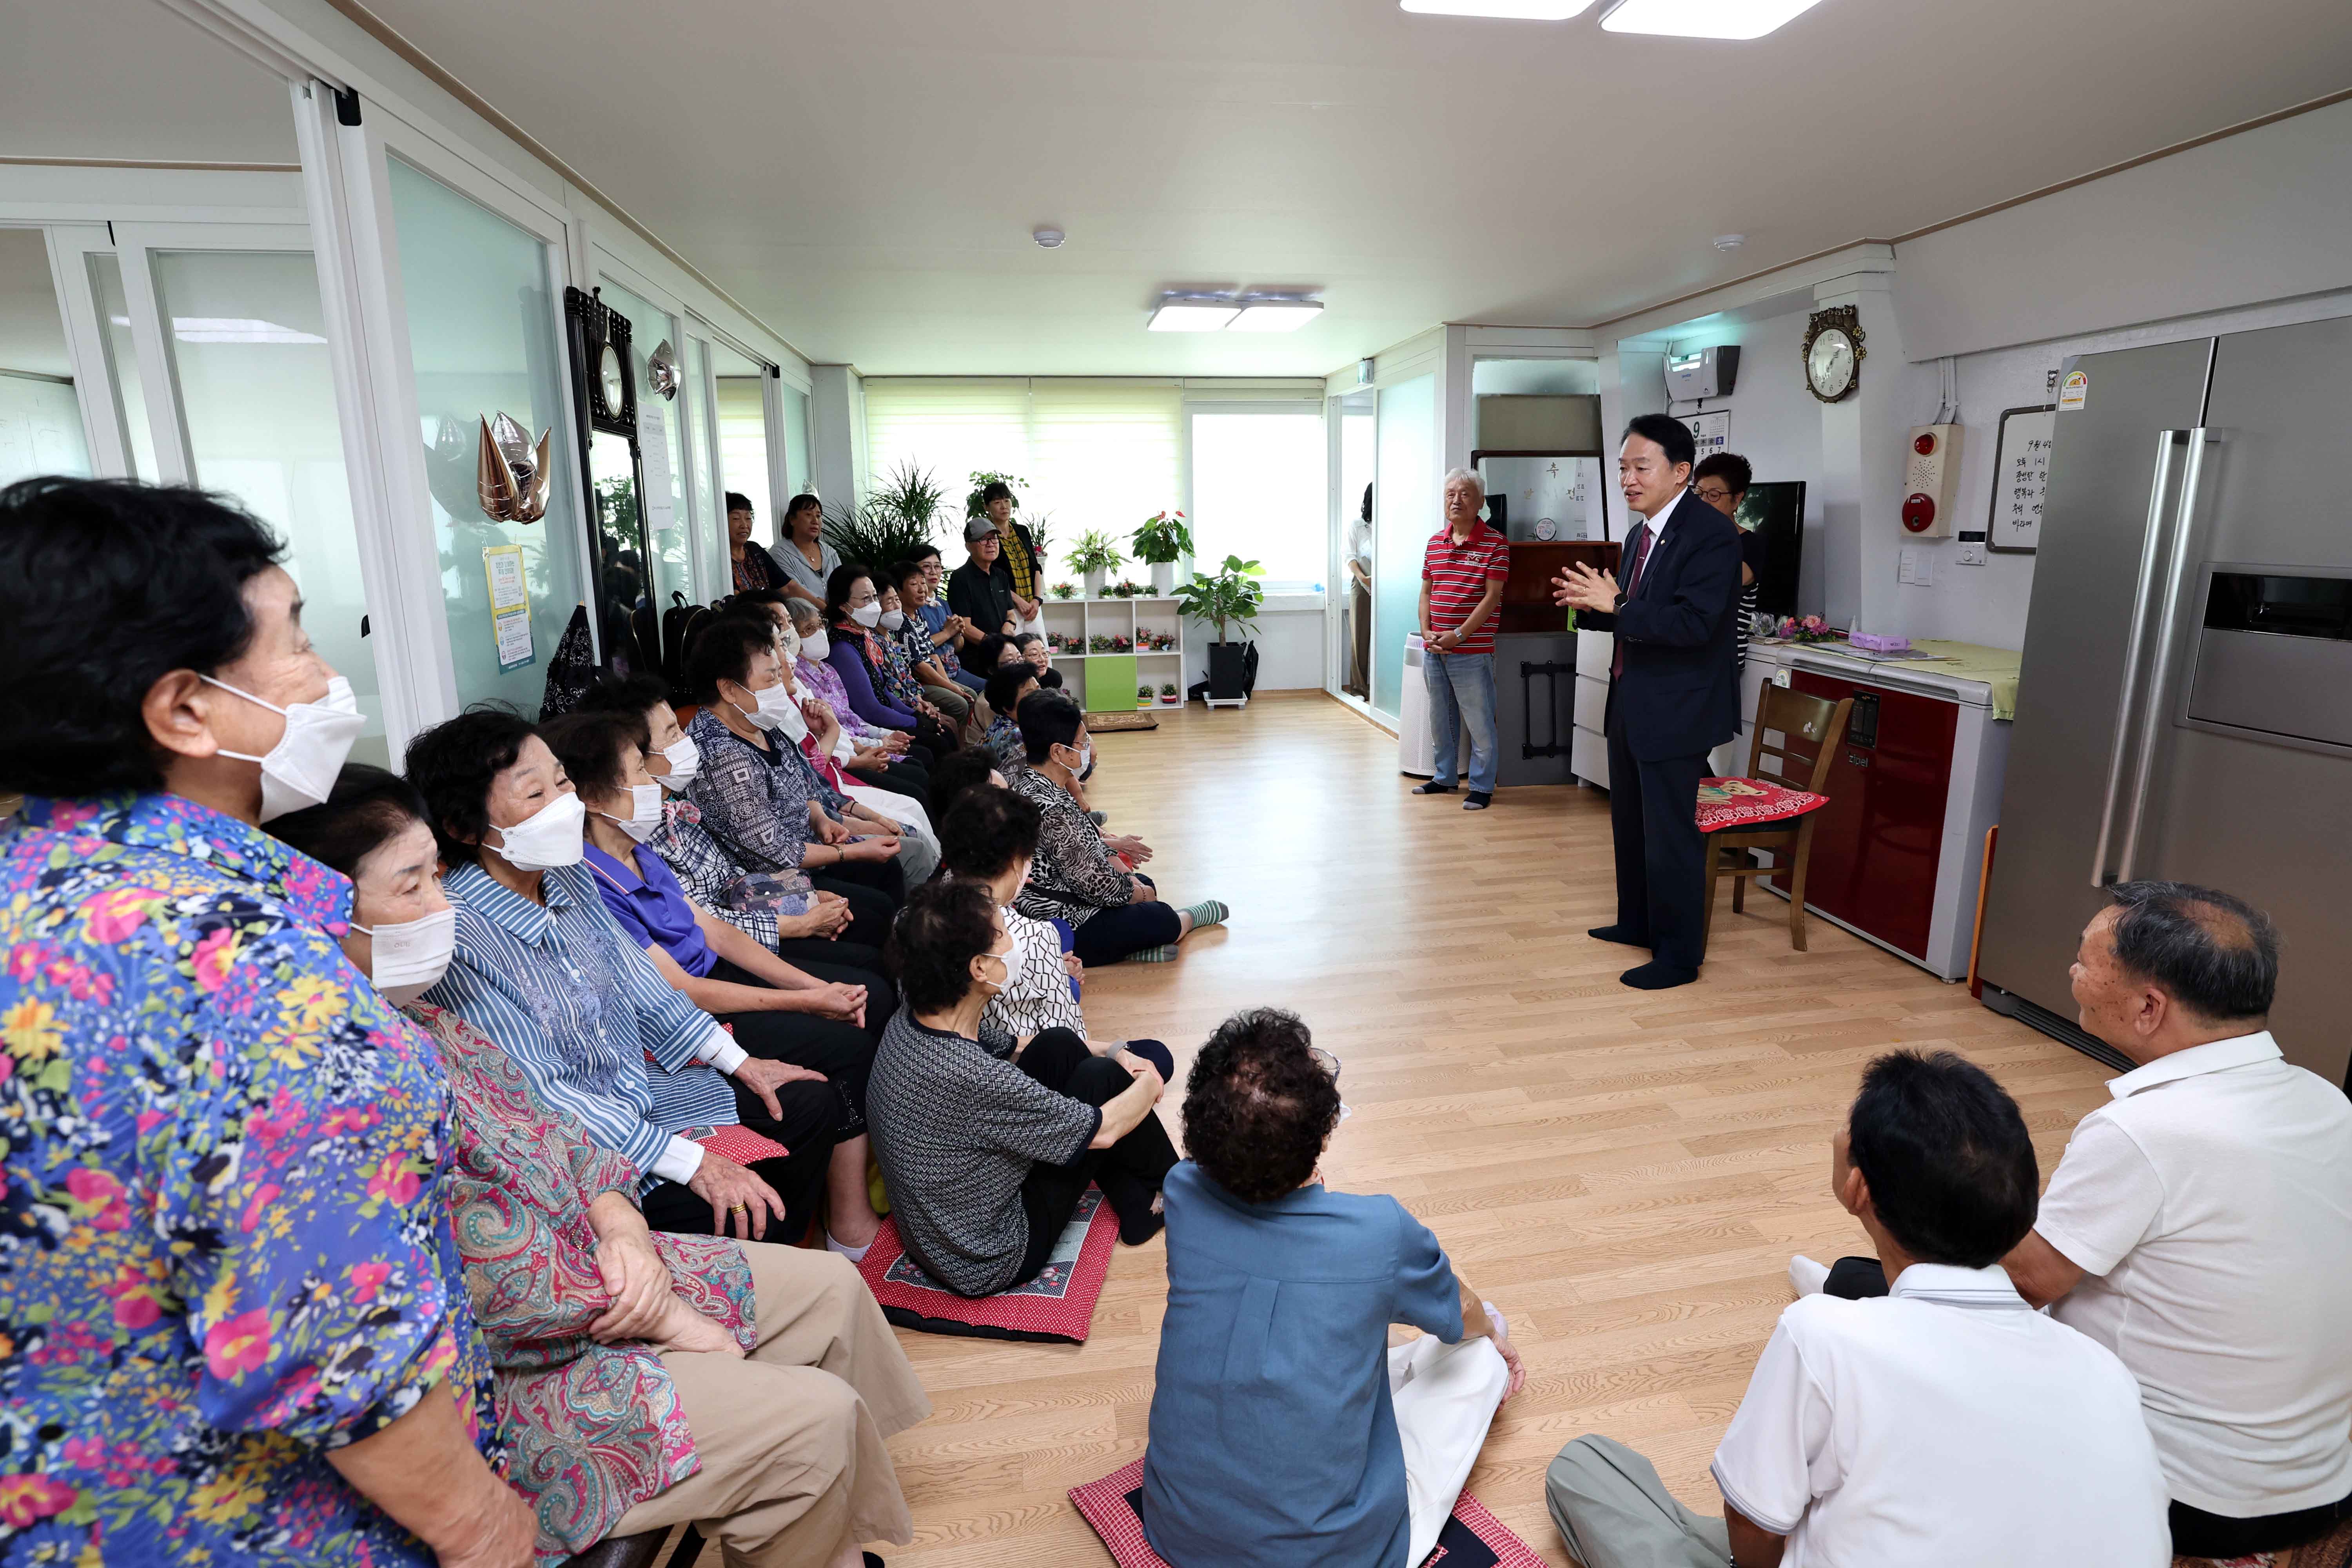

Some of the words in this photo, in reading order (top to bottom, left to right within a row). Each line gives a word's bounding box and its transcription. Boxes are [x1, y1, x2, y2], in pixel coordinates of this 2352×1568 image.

[1693, 421, 1700, 439] 9
[2027, 440, 2041, 452] 9월
[2035, 457, 2045, 466] 1시
[1546, 462, 1559, 479] 축
[2014, 487, 2035, 499] 행복과
[2012, 503, 2023, 515] 추석
[2012, 518, 2032, 532] 바라며
